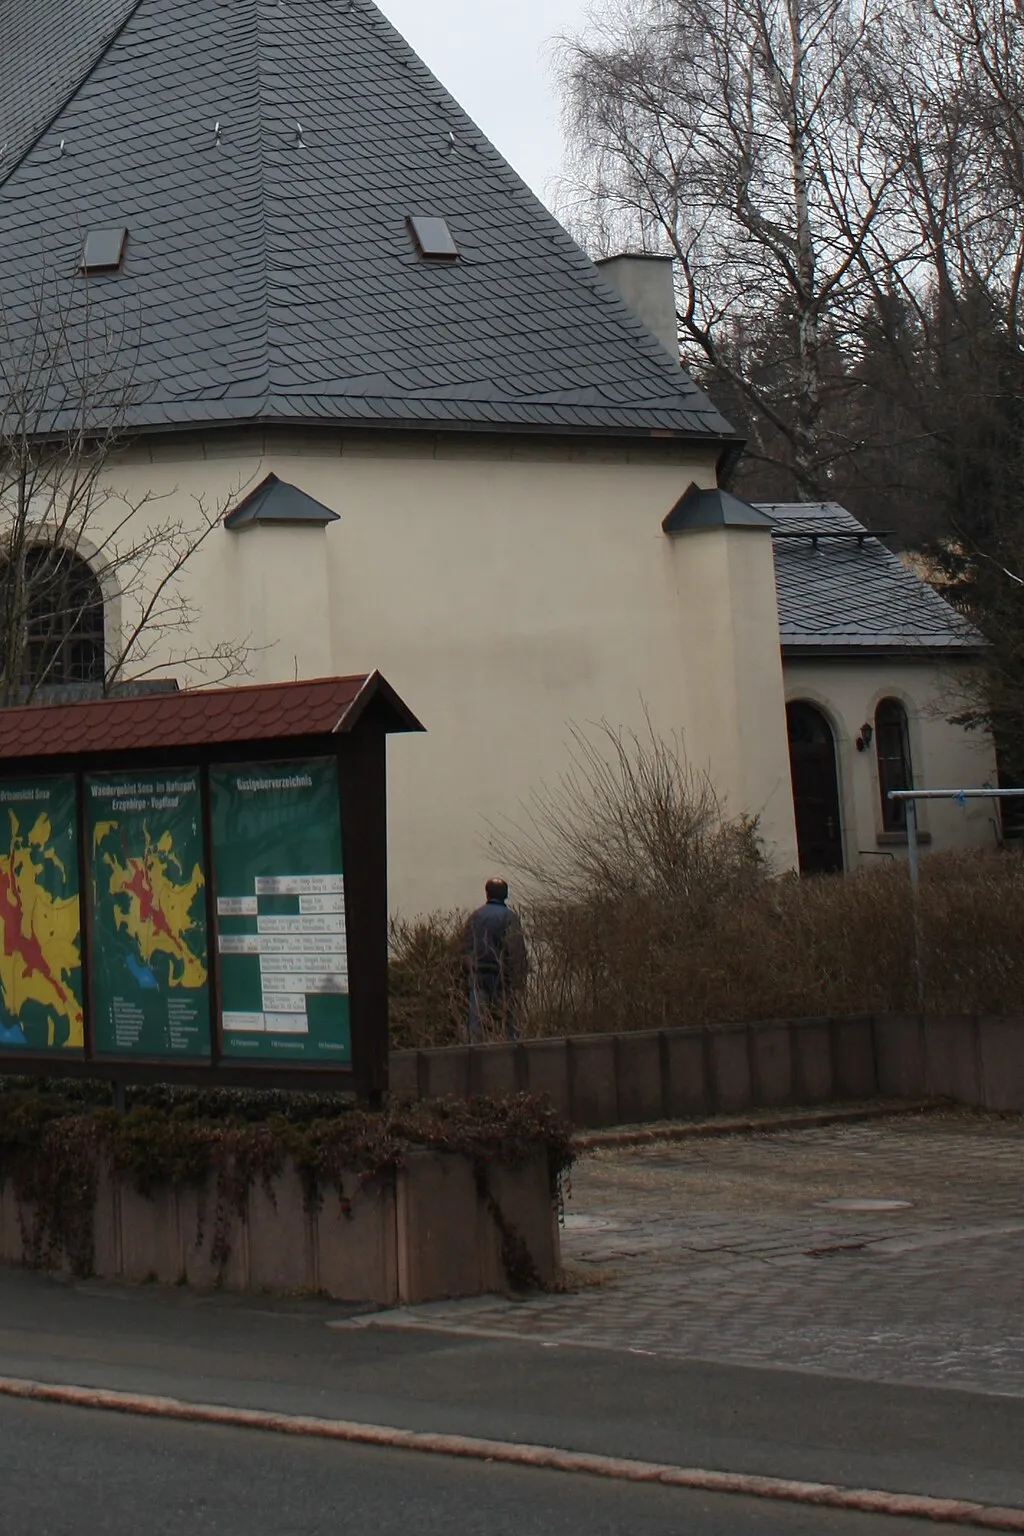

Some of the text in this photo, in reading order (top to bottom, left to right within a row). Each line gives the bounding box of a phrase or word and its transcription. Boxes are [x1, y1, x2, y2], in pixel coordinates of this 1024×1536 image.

[90, 783, 136, 797] Wandergebiet
[156, 782, 165, 793] im
[166, 779, 196, 794] Naturpark
[236, 774, 313, 792] Gastgeberverzeichnis
[112, 797, 146, 811] Erzgebirge
[151, 795, 179, 811] Vogtland
